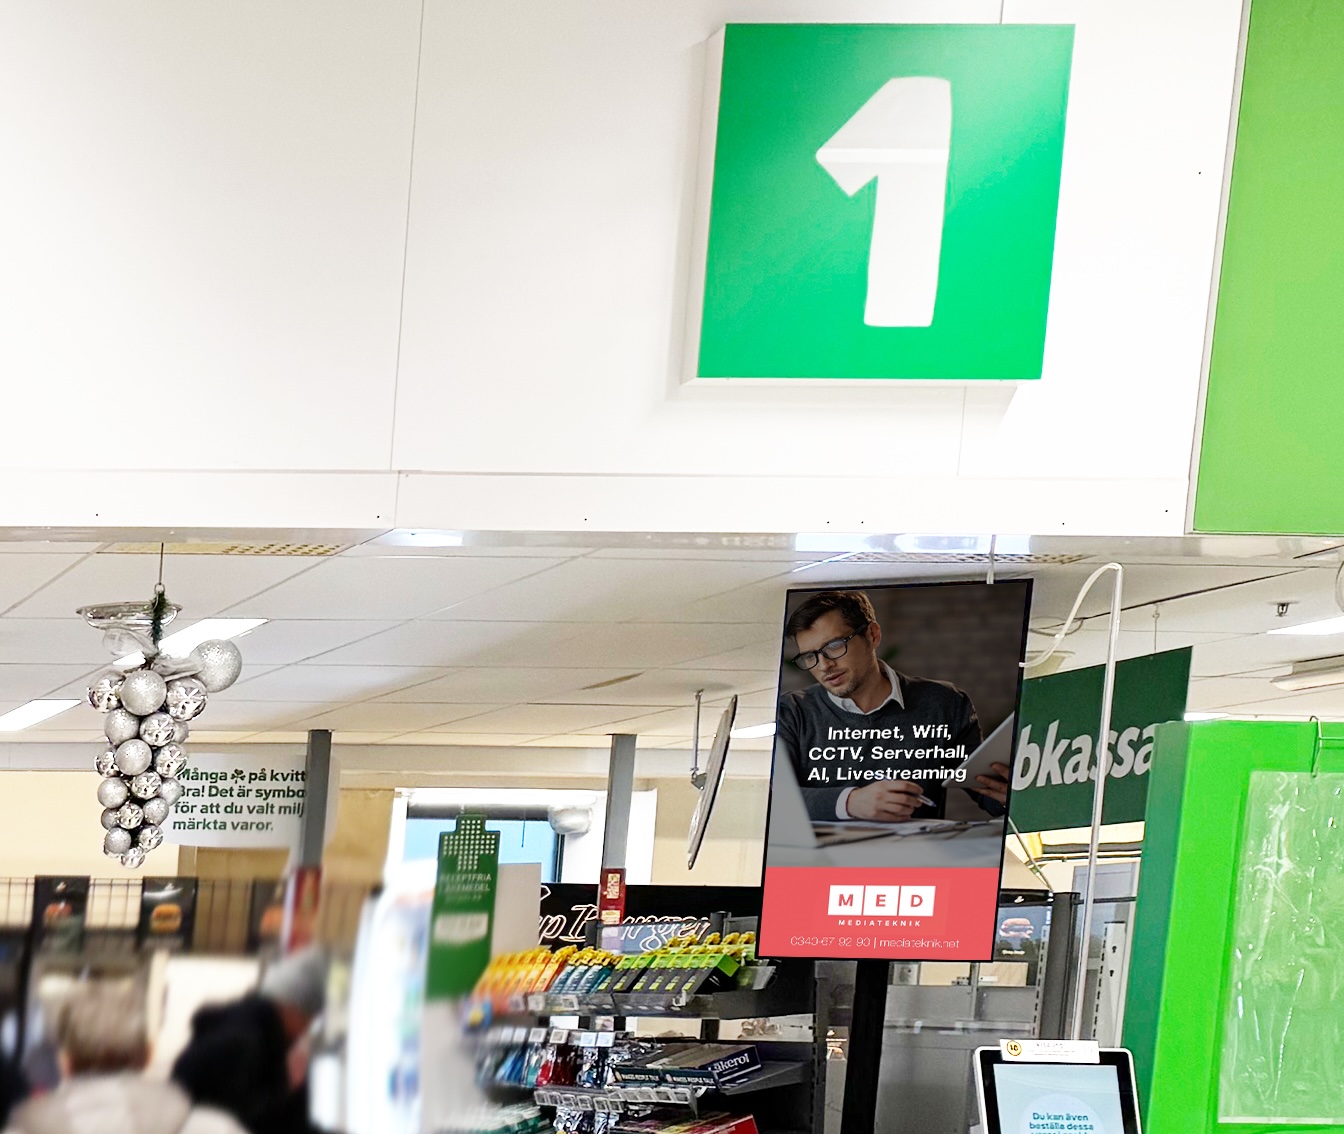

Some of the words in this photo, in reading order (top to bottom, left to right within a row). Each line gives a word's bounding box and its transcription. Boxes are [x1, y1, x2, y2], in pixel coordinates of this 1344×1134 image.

[815, 76, 952, 328] 1
[828, 726, 904, 743] Internet,
[912, 725, 952, 742] Wifi,
[808, 747, 864, 766] CCTV,
[871, 744, 969, 763] Serverhall,
[1013, 719, 1155, 791] bkassa
[177, 767, 227, 784] Många
[248, 766, 267, 785] på
[807, 767, 830, 784] AI,
[836, 766, 967, 783] Livestreaming
[179, 784, 205, 798] Bra!
[208, 785, 234, 798] Det
[237, 785, 252, 798] är
[175, 801, 196, 815] för
[200, 802, 221, 815] att
[224, 802, 243, 815] du
[246, 802, 277, 815] valt
[173, 818, 227, 832] märkta
[230, 821, 274, 832] varor.
[838, 894, 924, 908] MED
[838, 919, 922, 927] MEDIATEKNIK
[838, 936, 853, 948] 92
[856, 936, 871, 948] 90
[1032, 1113, 1045, 1121] Du
[1047, 1113, 1064, 1121] kan
[1065, 1112, 1089, 1121] även
